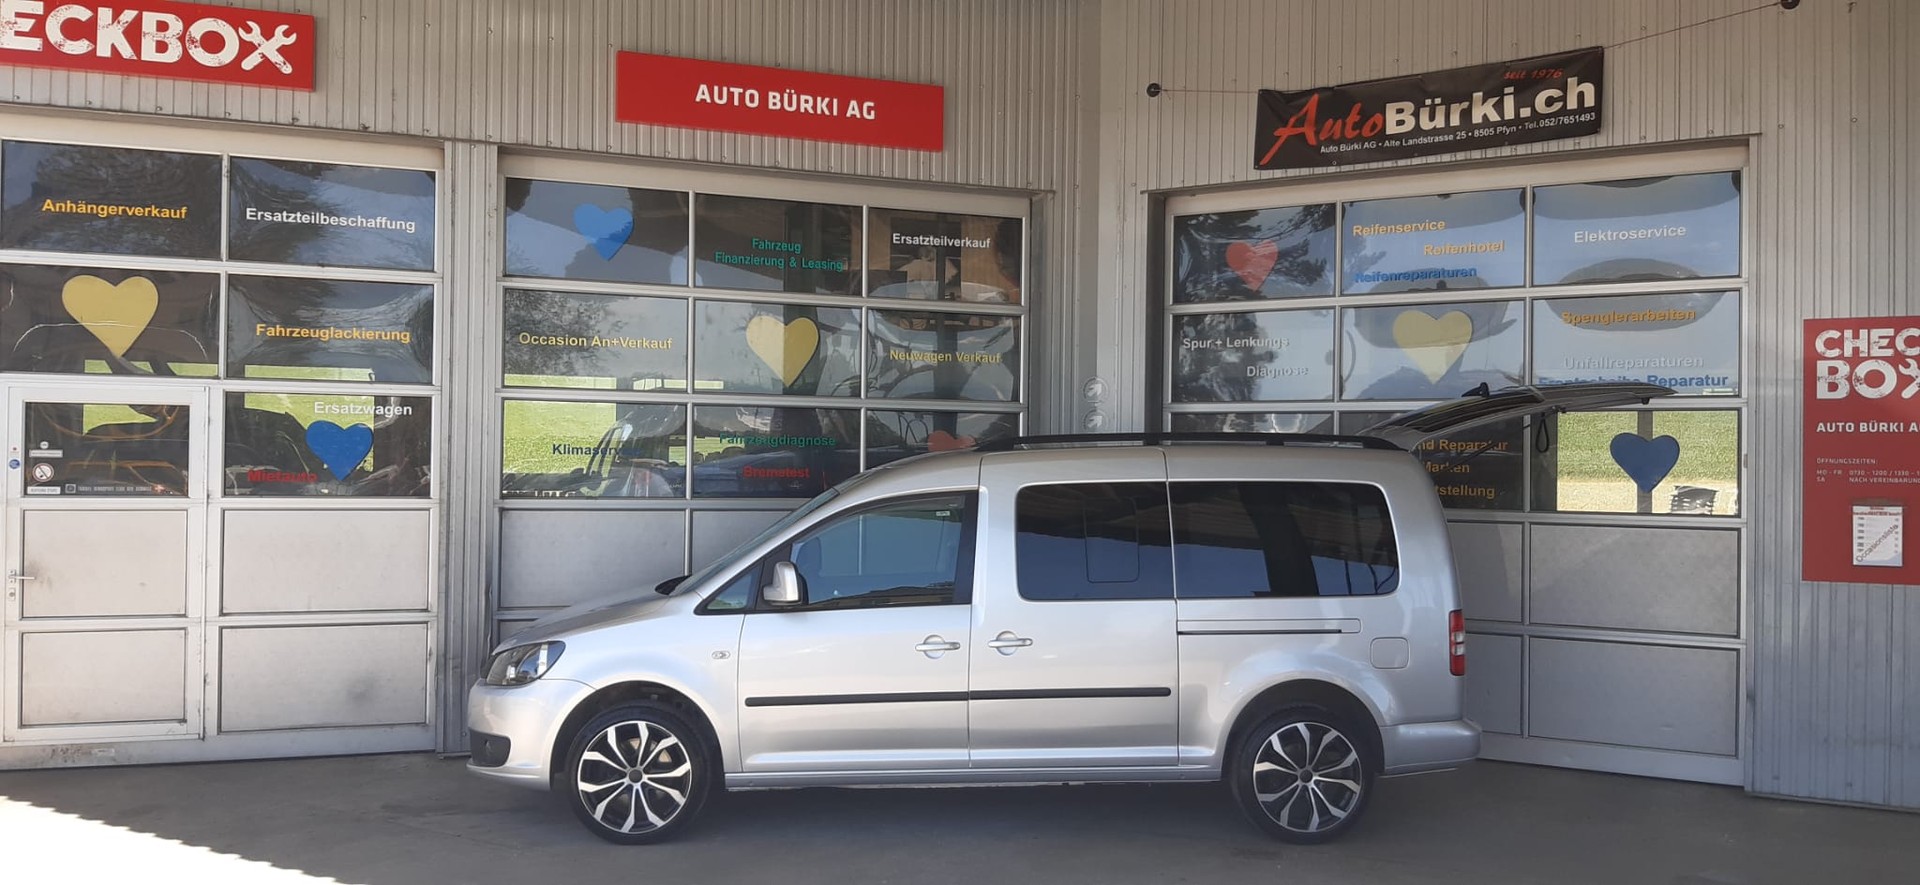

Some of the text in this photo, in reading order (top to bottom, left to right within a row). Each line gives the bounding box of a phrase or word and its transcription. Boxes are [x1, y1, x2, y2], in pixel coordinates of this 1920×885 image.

[1504, 68, 1564, 79] seit 1976
[695, 83, 876, 120] AUTO BÜRKI AG
[1320, 145, 1338, 153] Auto
[1340, 142, 1361, 152] Bürki
[1363, 141, 1376, 149] AG
[1402, 134, 1454, 146] Landstrasse
[1456, 131, 1467, 140] 25
[1474, 129, 1495, 137] 8505
[1496, 125, 1517, 135] Pfyn
[42, 198, 187, 220] Anhängerverkauf
[246, 207, 416, 234] Ersatzteilbeschaffung
[1353, 220, 1446, 236] Reifenservice
[892, 233, 990, 248] Ersatzteilverkauf
[1574, 225, 1687, 243] Elektroservice
[752, 238, 801, 254] Fahrzeug
[1423, 240, 1505, 256] Reifenhotel
[715, 251, 844, 272] Finanzierung & Leasing
[1355, 267, 1477, 283] Reifenreparaturen
[1562, 309, 1696, 326] Spenglerarbeiten
[256, 323, 411, 344] Fahrzeuglackierung
[519, 332, 587, 346] Occasion
[1183, 338, 1212, 351] Spur
[1226, 337, 1290, 350] Lenkungs
[1815, 328, 1920, 358] CHEC
[890, 349, 1001, 366] Neuwagen Verkauf
[1564, 356, 1704, 370] Unfallreparaturen
[1647, 374, 1729, 387] Reparatur
[314, 401, 412, 418] Ersatzwagen
[1816, 420, 1920, 433] AUTO BÜRKI A
[552, 444, 641, 456] Klimaserv
